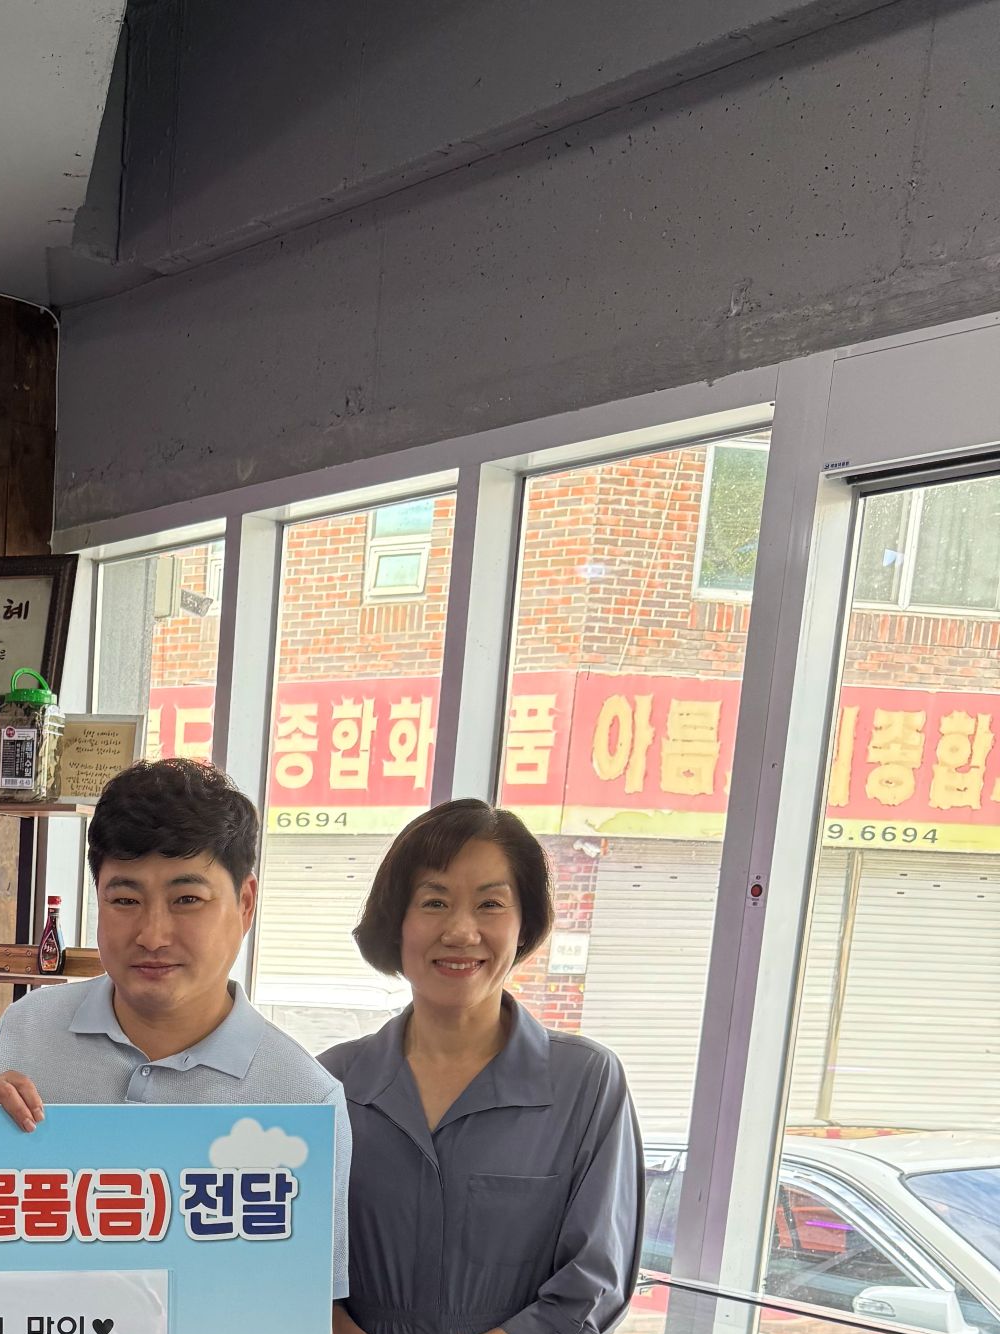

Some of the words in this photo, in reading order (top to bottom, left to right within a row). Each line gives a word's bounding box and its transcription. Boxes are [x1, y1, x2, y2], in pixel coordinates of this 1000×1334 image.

[592, 694, 731, 795] 아름
[865, 708, 1000, 810] 종합
[277, 811, 348, 828] 6694
[827, 823, 938, 844] 9.6694
[180, 1167, 298, 1240] 전달
